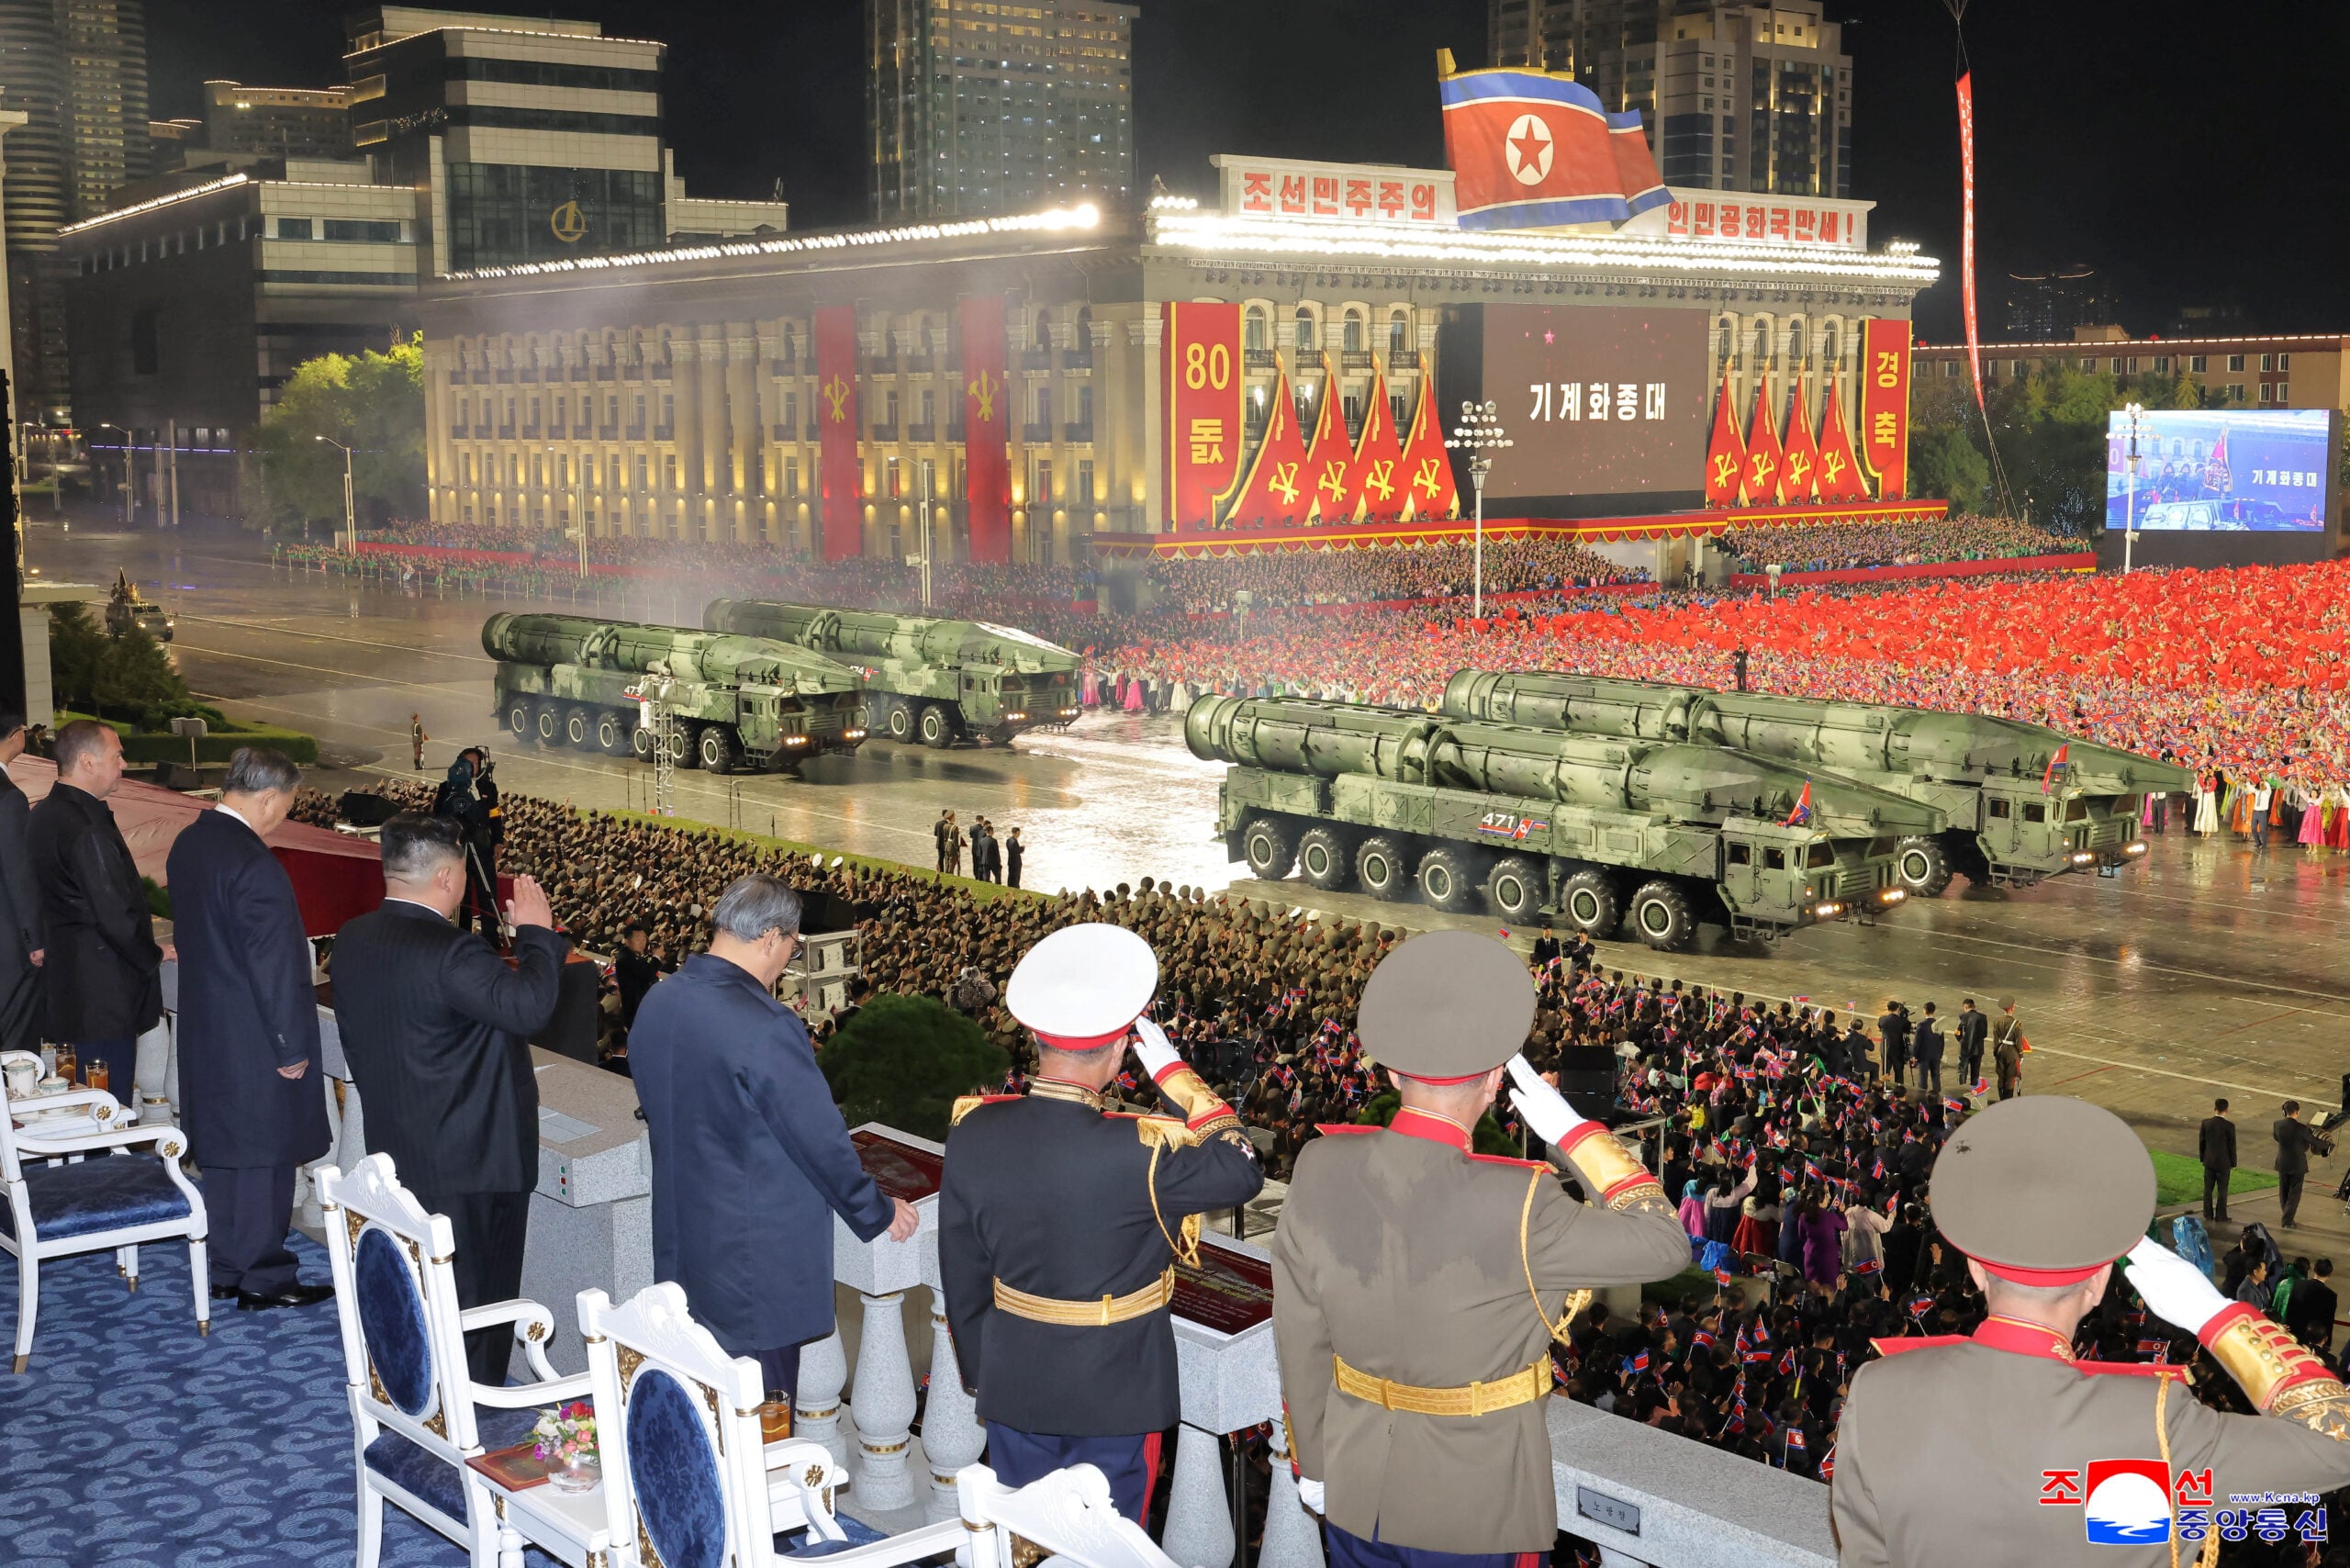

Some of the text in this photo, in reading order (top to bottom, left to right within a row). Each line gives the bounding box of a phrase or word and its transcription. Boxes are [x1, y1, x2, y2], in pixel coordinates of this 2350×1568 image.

[1244, 173, 1854, 244] 조선민주주의 인민공화국만세!
[1185, 342, 1230, 465] 80 돐
[1529, 383, 1666, 421] 기계화종대
[1874, 352, 1899, 449] 경축
[2252, 469, 2318, 487] 기계화종대
[1481, 812, 1515, 829] 471
